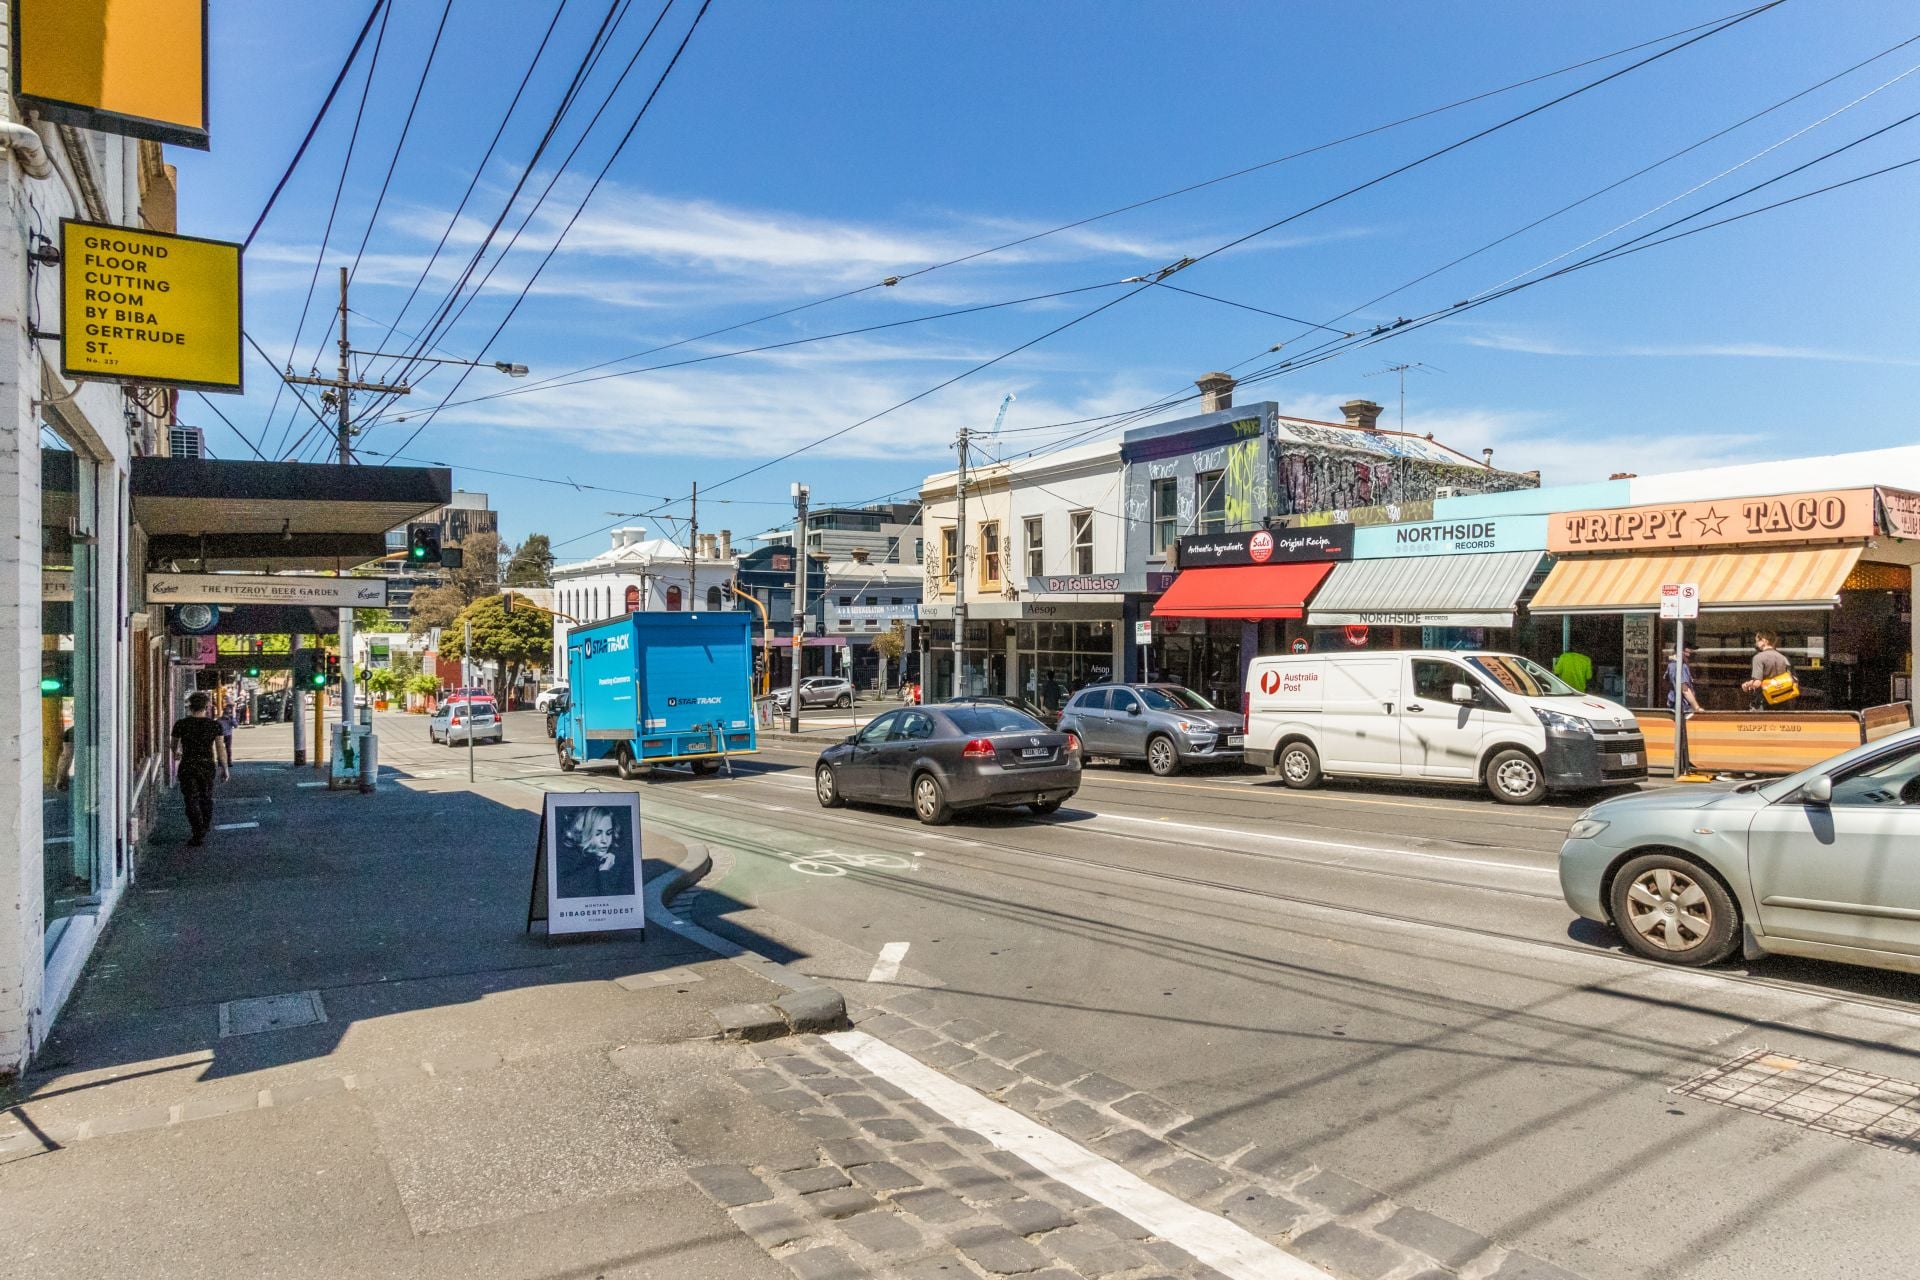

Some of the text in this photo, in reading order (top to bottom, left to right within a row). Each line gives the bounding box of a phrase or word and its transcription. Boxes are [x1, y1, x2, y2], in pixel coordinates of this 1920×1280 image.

[85, 237, 168, 258] GROUND
[85, 254, 147, 272] FLOOR
[85, 272, 170, 292] CUTTING
[86, 289, 143, 306] ROOM
[86, 306, 158, 325] BY BIBA
[86, 324, 185, 345] GERTRUDE
[86, 341, 112, 354] ST.
[1565, 496, 1847, 544] TRIPPY TACO
[1396, 522, 1496, 543] NORTHSIDE
[1455, 540, 1495, 550] RECORDS
[202, 585, 221, 593] THE
[224, 586, 268, 594] FITZROY
[272, 587, 297, 595] BEER
[300, 588, 339, 596] GARDEN
[1049, 578, 1065, 591] Dr
[1359, 613, 1421, 624] NORTHSIDE
[1284, 673, 1318, 681] Australia
[1283, 684, 1301, 692] Post
[560, 907, 634, 917] BIBAGERTRUDEST
